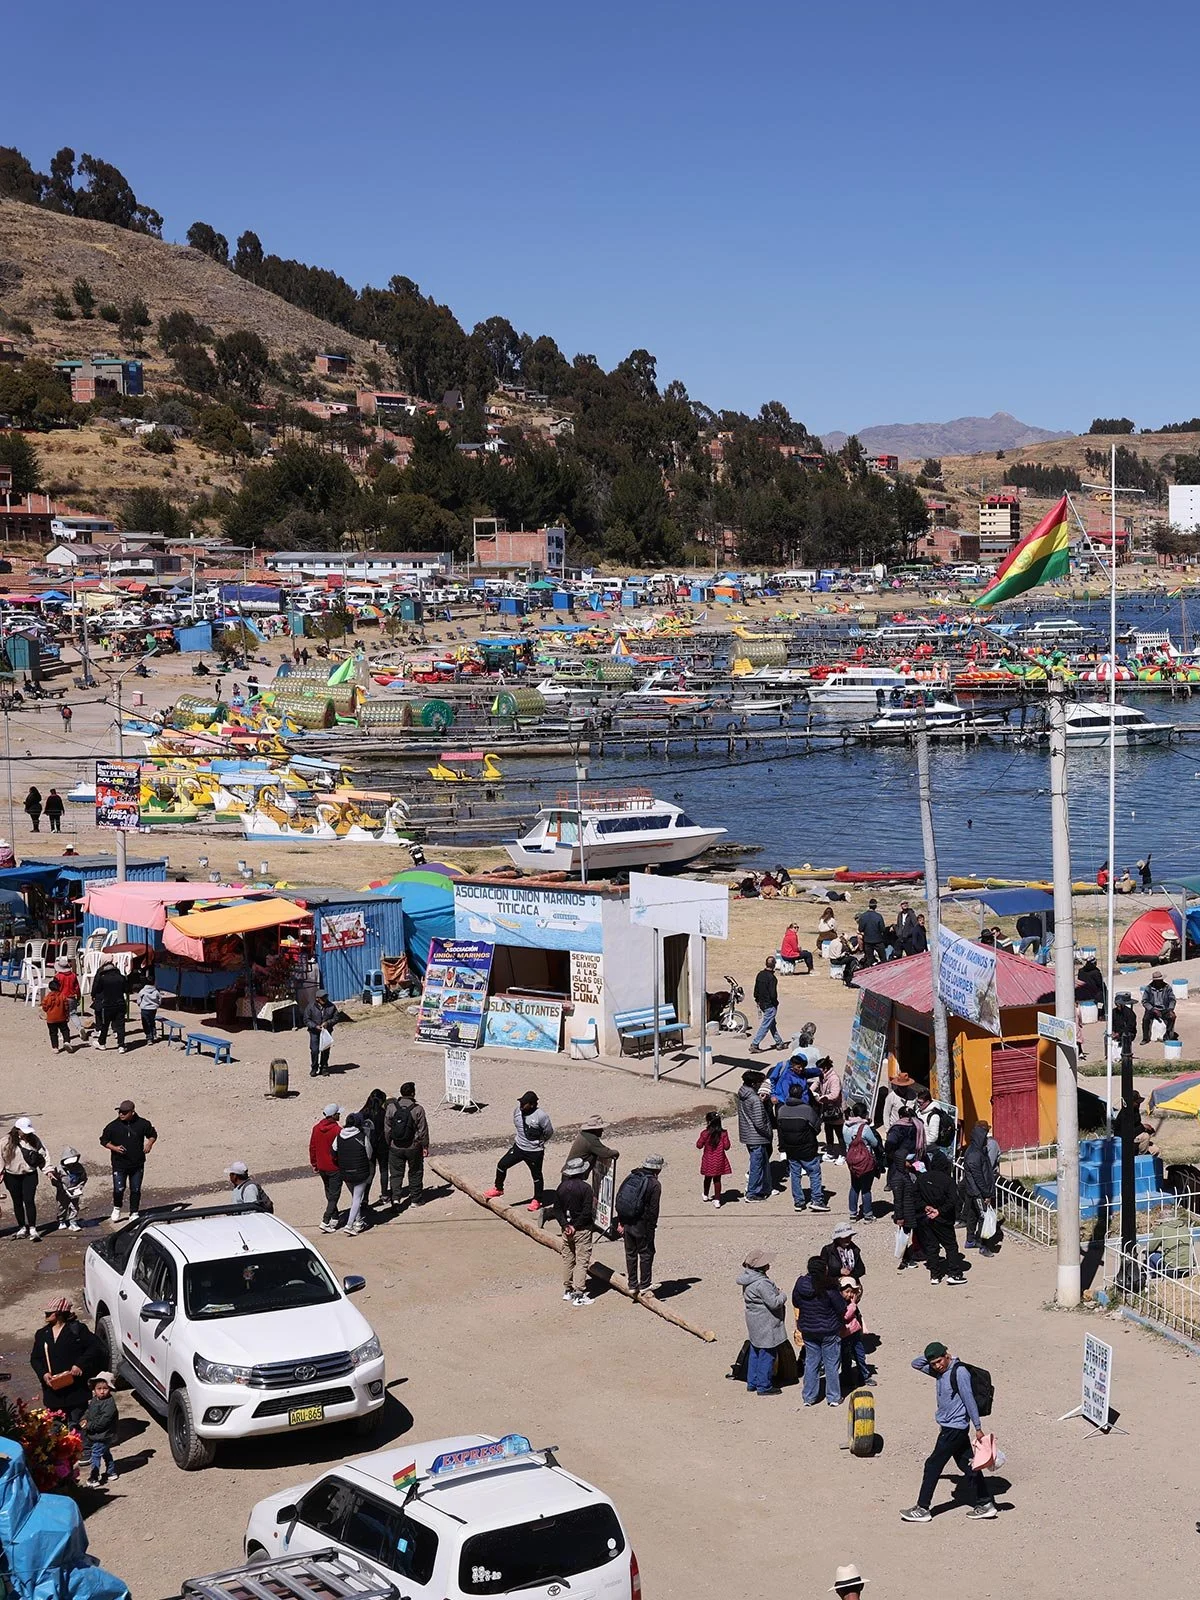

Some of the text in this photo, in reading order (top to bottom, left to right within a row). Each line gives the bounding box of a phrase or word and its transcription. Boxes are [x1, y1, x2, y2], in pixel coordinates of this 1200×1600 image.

[512, 890, 540, 902] UNION
[543, 892, 586, 906] MARINOS
[497, 902, 539, 916] TITICACA
[445, 945, 478, 953] ASOCIACIÓN
[571, 953, 600, 963] SERVICIO
[575, 961, 598, 970] DIARIO
[584, 969, 597, 977] LAS
[572, 975, 603, 985] ISLAS DEL
[573, 983, 602, 995] SOL Y
[573, 992, 599, 1005] LUNA
[514, 1002, 560, 1018] FLOTANTES
[442, 1443, 504, 1467] EXPRESS
